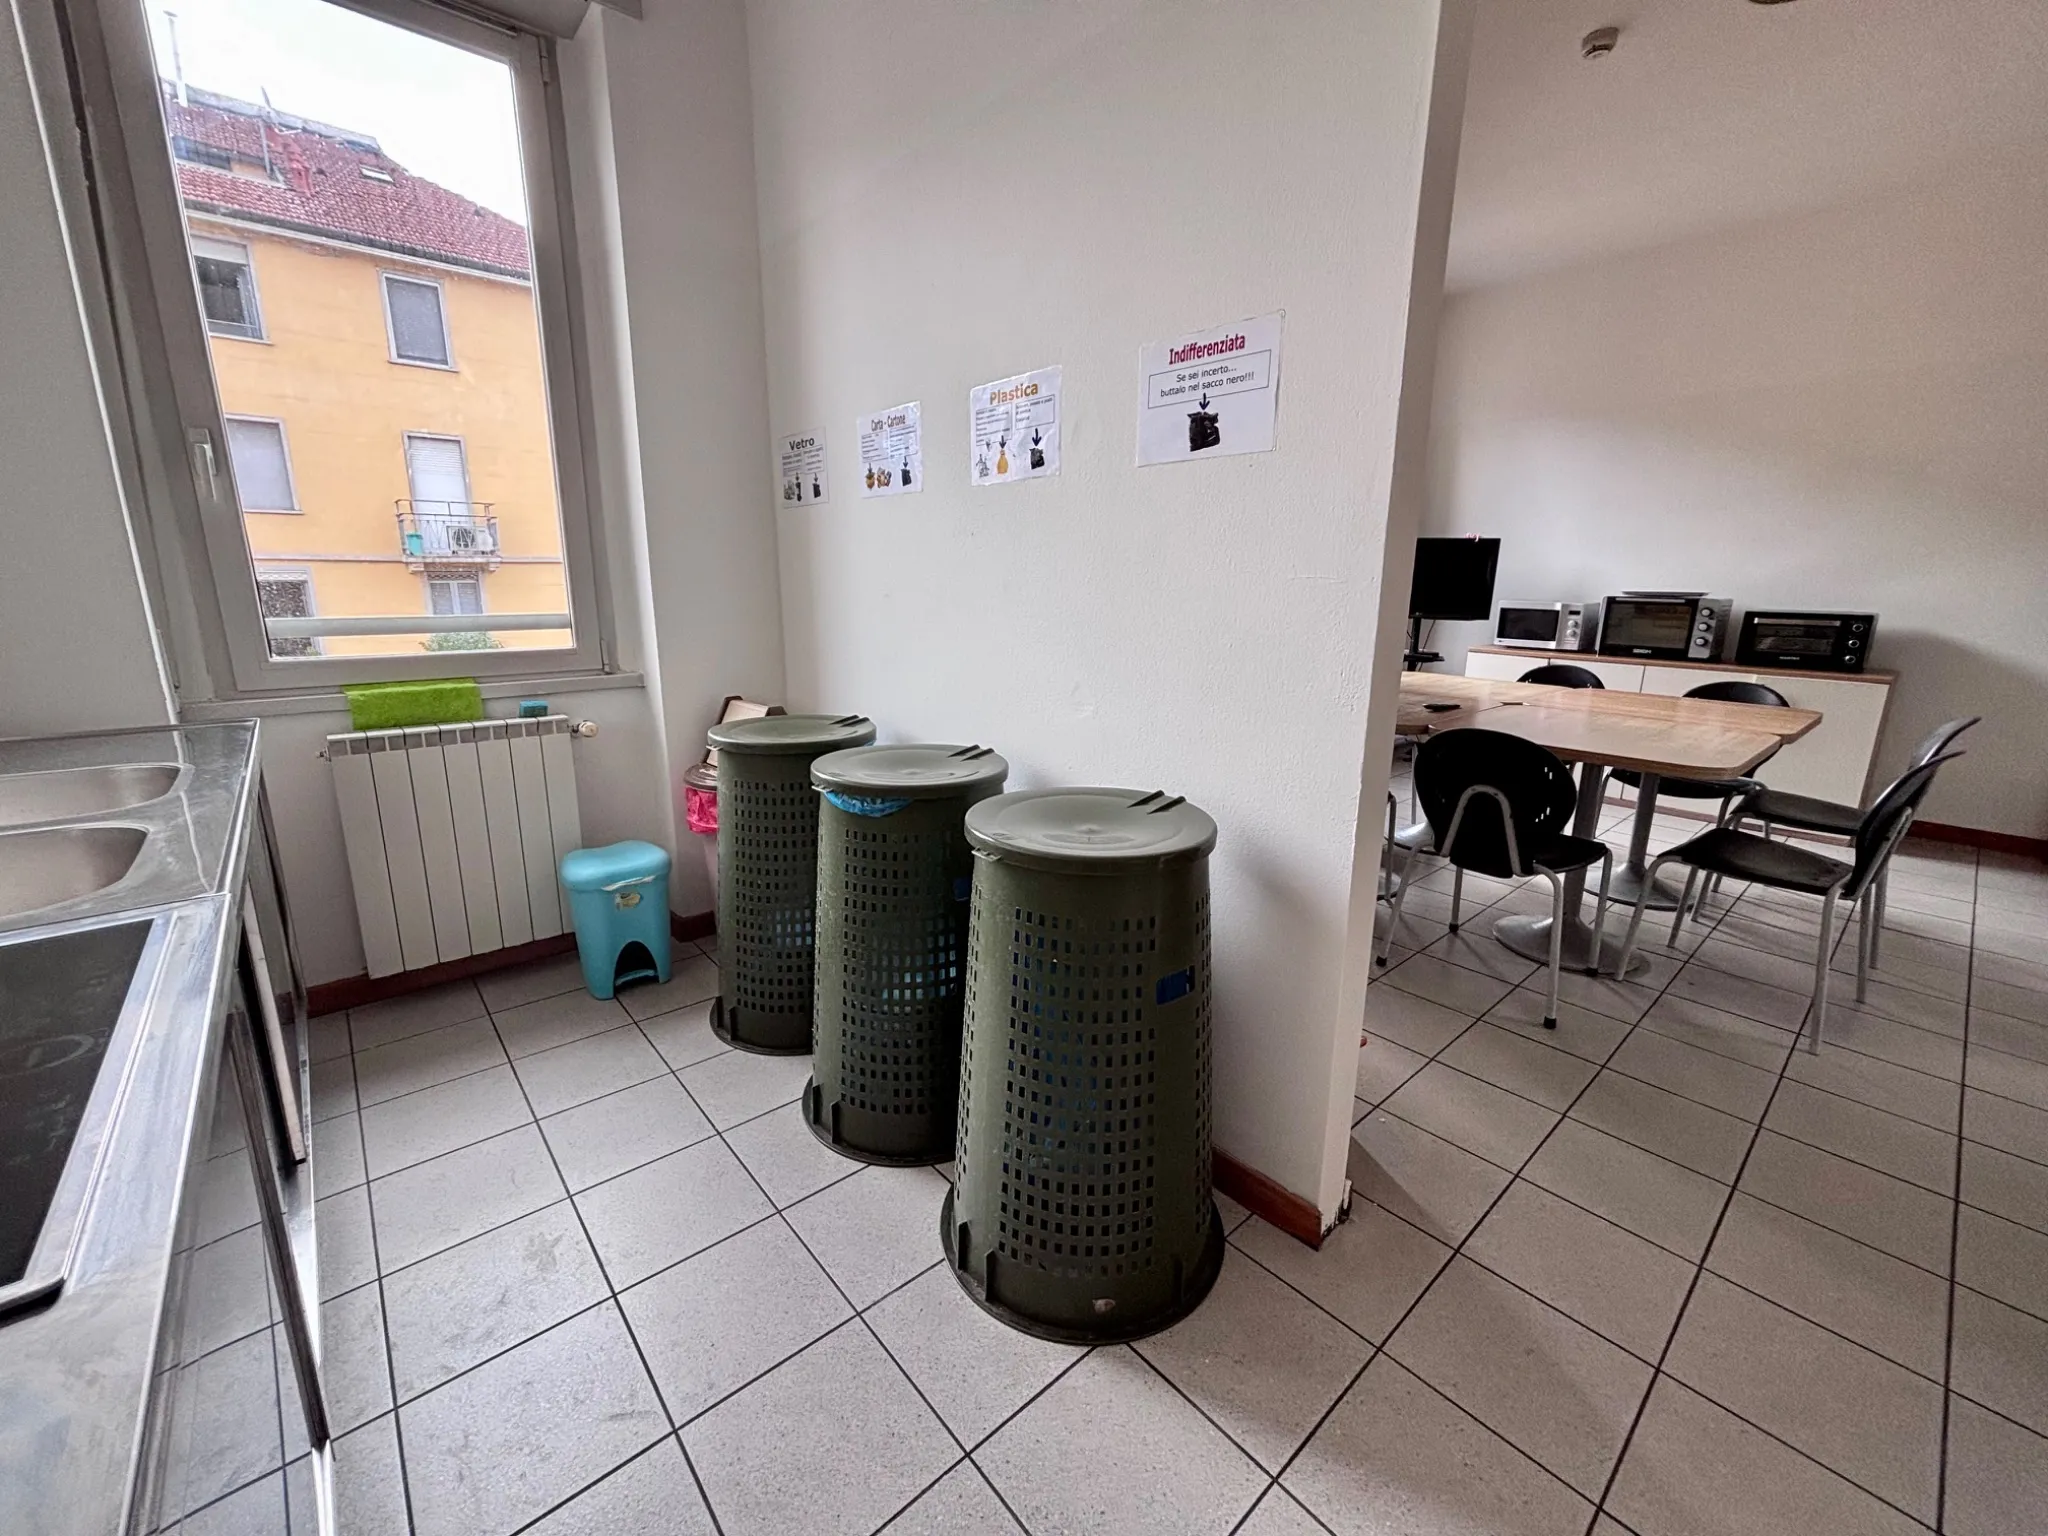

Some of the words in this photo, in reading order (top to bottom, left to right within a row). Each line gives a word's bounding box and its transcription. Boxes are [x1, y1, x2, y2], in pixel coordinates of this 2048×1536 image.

[1169, 333, 1246, 365] Indifferenziata
[1176, 373, 1187, 383] Se
[1188, 370, 1199, 381] sei
[1201, 365, 1237, 378] incerto...
[1188, 381, 1200, 392] nel
[1202, 379, 1224, 390] sacco
[1226, 371, 1255, 385] nero!!!
[990, 383, 1039, 405] Plastica
[871, 418, 884, 432] Carta
[887, 414, 906, 428] Cartone
[789, 437, 815, 451] Vetro
